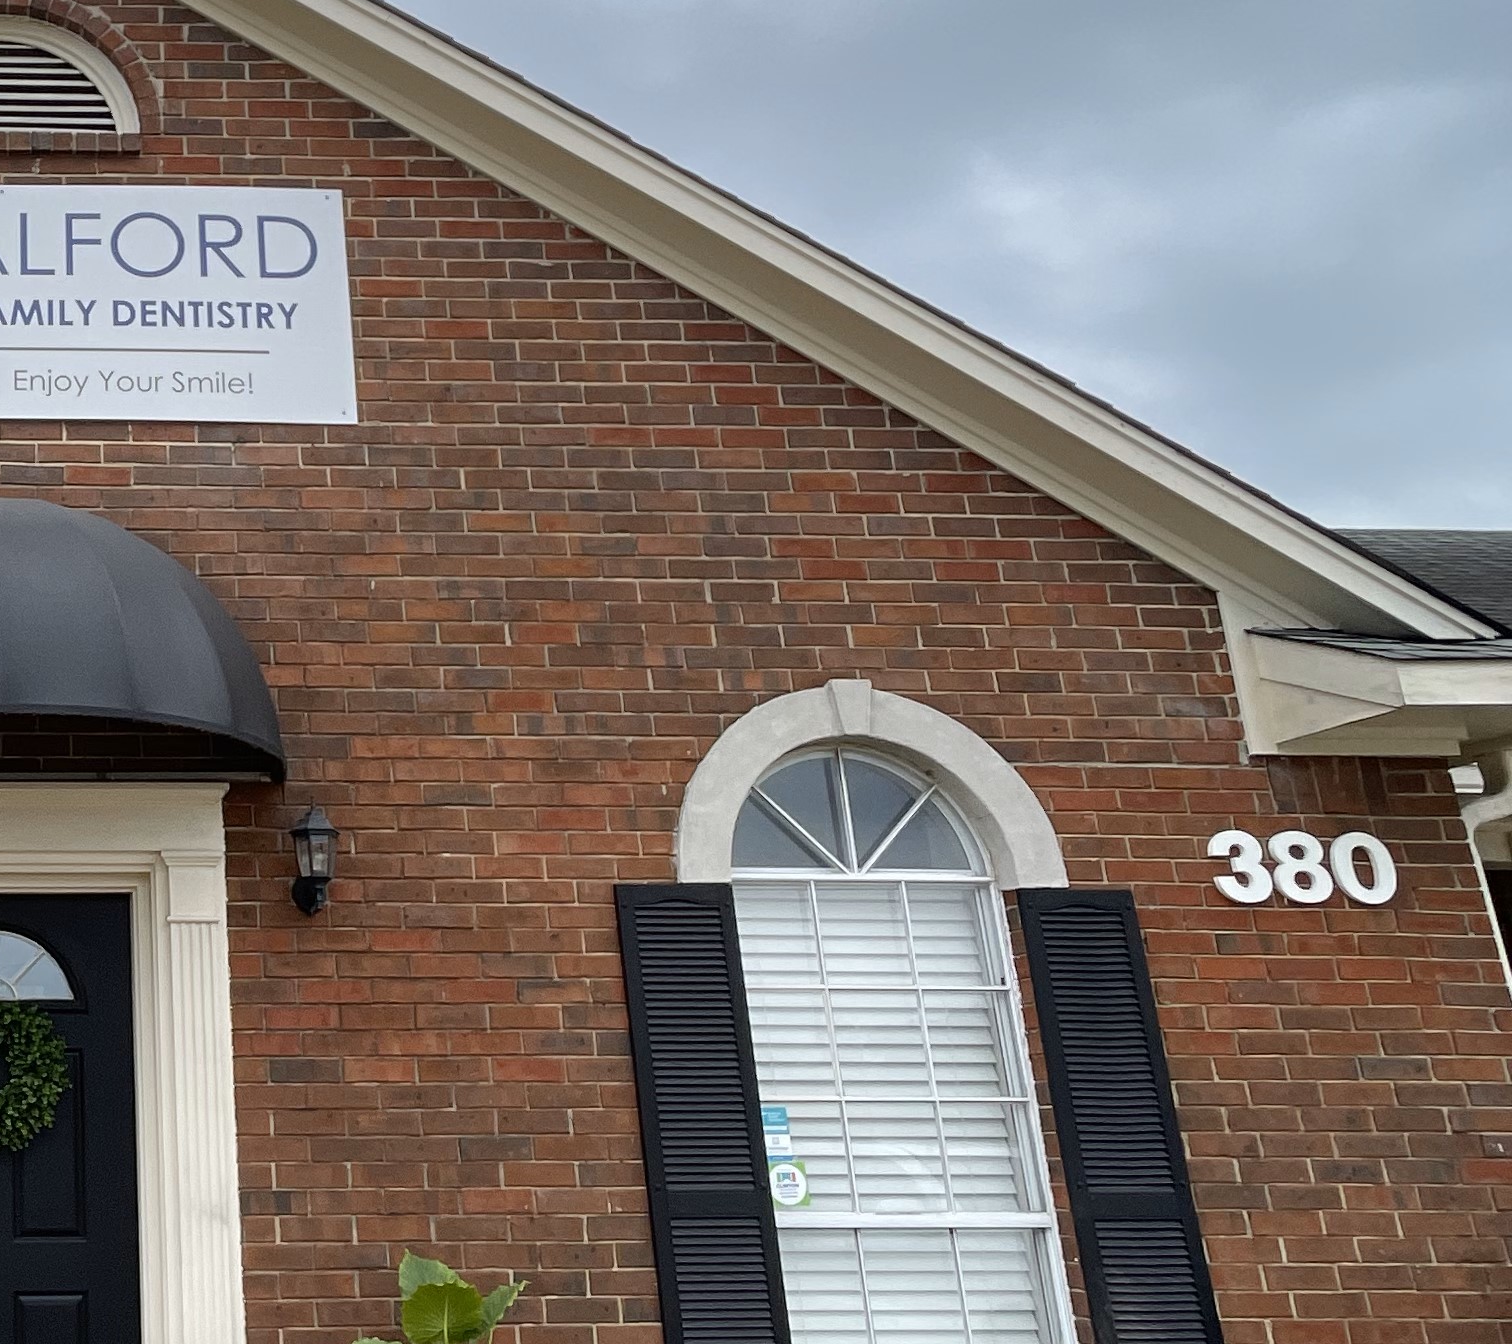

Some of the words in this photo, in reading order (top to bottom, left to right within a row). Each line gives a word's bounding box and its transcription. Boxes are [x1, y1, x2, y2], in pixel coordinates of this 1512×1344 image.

[113, 299, 299, 330] DENTISTRY
[13, 369, 89, 398] Enjoy
[98, 369, 164, 394] Your
[172, 370, 255, 395] Smile!
[1207, 829, 1398, 905] 380
